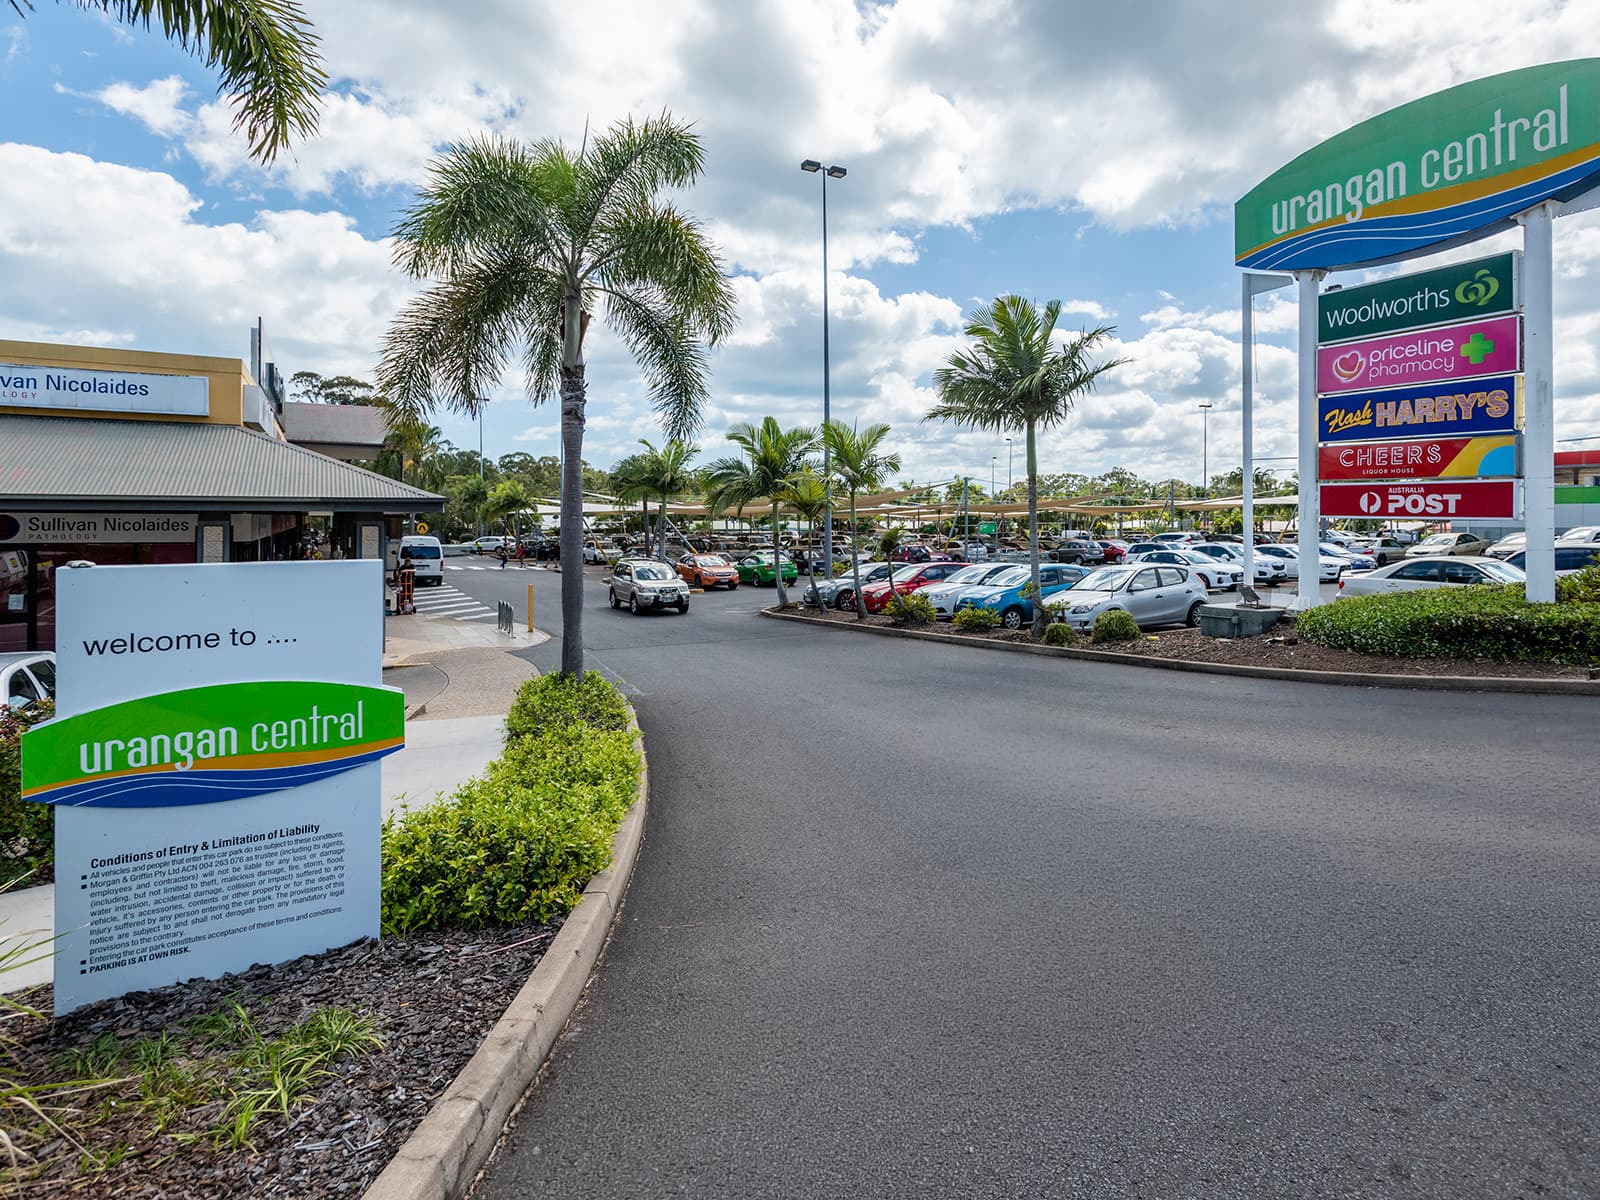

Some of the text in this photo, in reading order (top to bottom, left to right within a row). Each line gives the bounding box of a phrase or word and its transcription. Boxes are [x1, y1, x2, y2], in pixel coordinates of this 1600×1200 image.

[1272, 84, 1568, 235] urangan central
[1369, 338, 1454, 366] priceline
[1369, 356, 1455, 381] pharmacy
[46, 374, 149, 396] Nicolaides
[1324, 389, 1509, 433] Flash HARRY'S
[1339, 444, 1442, 467] CHEERS
[1387, 494, 1462, 514] POST
[28, 517, 189, 532] Sullivan Nicolaides
[82, 633, 220, 656] welcome
[230, 628, 256, 646] to
[79, 700, 363, 774] urangan central
[90, 824, 319, 868] Conditions of Entry & Limitation of Liability
[101, 867, 130, 876] vehicles
[146, 860, 169, 870] people
[228, 847, 243, 856] park
[263, 840, 286, 849] subject
[90, 878, 120, 887] Morgan
[181, 864, 197, 872] ACN
[279, 846, 311, 856] (including
[89, 907, 111, 915] water
[153, 892, 190, 904] accidental
[226, 881, 255, 890] collision
[295, 868, 322, 878] suffered
[90, 885, 132, 896] employees
[153, 872, 198, 885] contractors)
[163, 883, 188, 893] limited
[221, 873, 254, 882] malicious
[187, 896, 218, 906] contents
[252, 885, 281, 896] property
[317, 874, 335, 882] death
[89, 926, 111, 934] injury
[114, 918, 145, 929] suffered
[174, 909, 199, 920] person
[201, 904, 229, 913] entering
[289, 886, 322, 897] provisions
[90, 935, 113, 944] notice
[133, 925, 160, 935] subject
[191, 916, 207, 924] shall
[225, 907, 254, 917] derogate
[292, 894, 326, 904] mandatory
[330, 889, 343, 897] legal
[89, 952, 121, 962] Entering
[148, 942, 165, 952] park
[166, 935, 205, 947] constitutes
[207, 927, 246, 938] acceptance
[89, 941, 129, 955] provisions
[89, 959, 126, 973] PARKING
[137, 954, 147, 963] AT
[148, 950, 168, 960] OWN
[169, 946, 190, 956] RISK.
